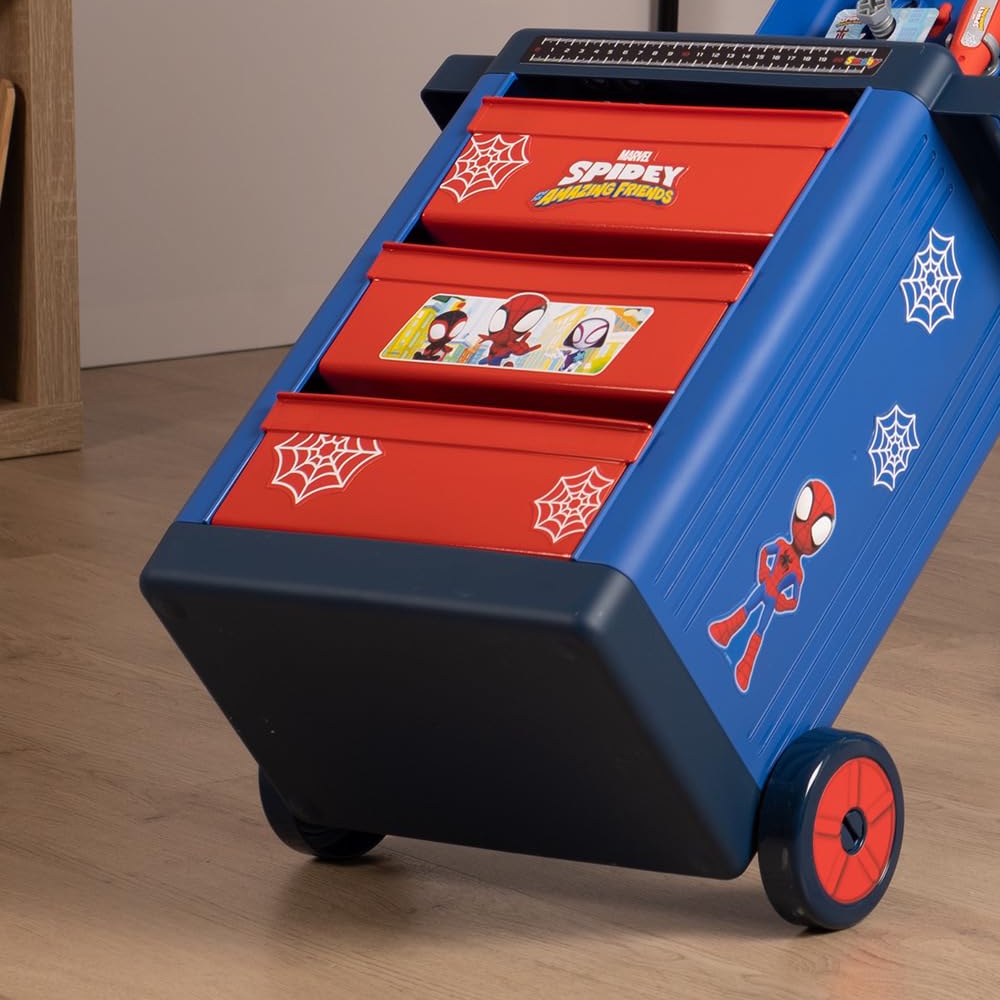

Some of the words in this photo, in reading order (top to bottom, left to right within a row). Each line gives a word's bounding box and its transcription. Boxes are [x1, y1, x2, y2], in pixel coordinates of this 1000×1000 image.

[616, 149, 653, 162] MARVEL
[557, 160, 685, 188] SPIDEY
[534, 182, 616, 206] AMAZING
[611, 181, 674, 205] FRIENDS
